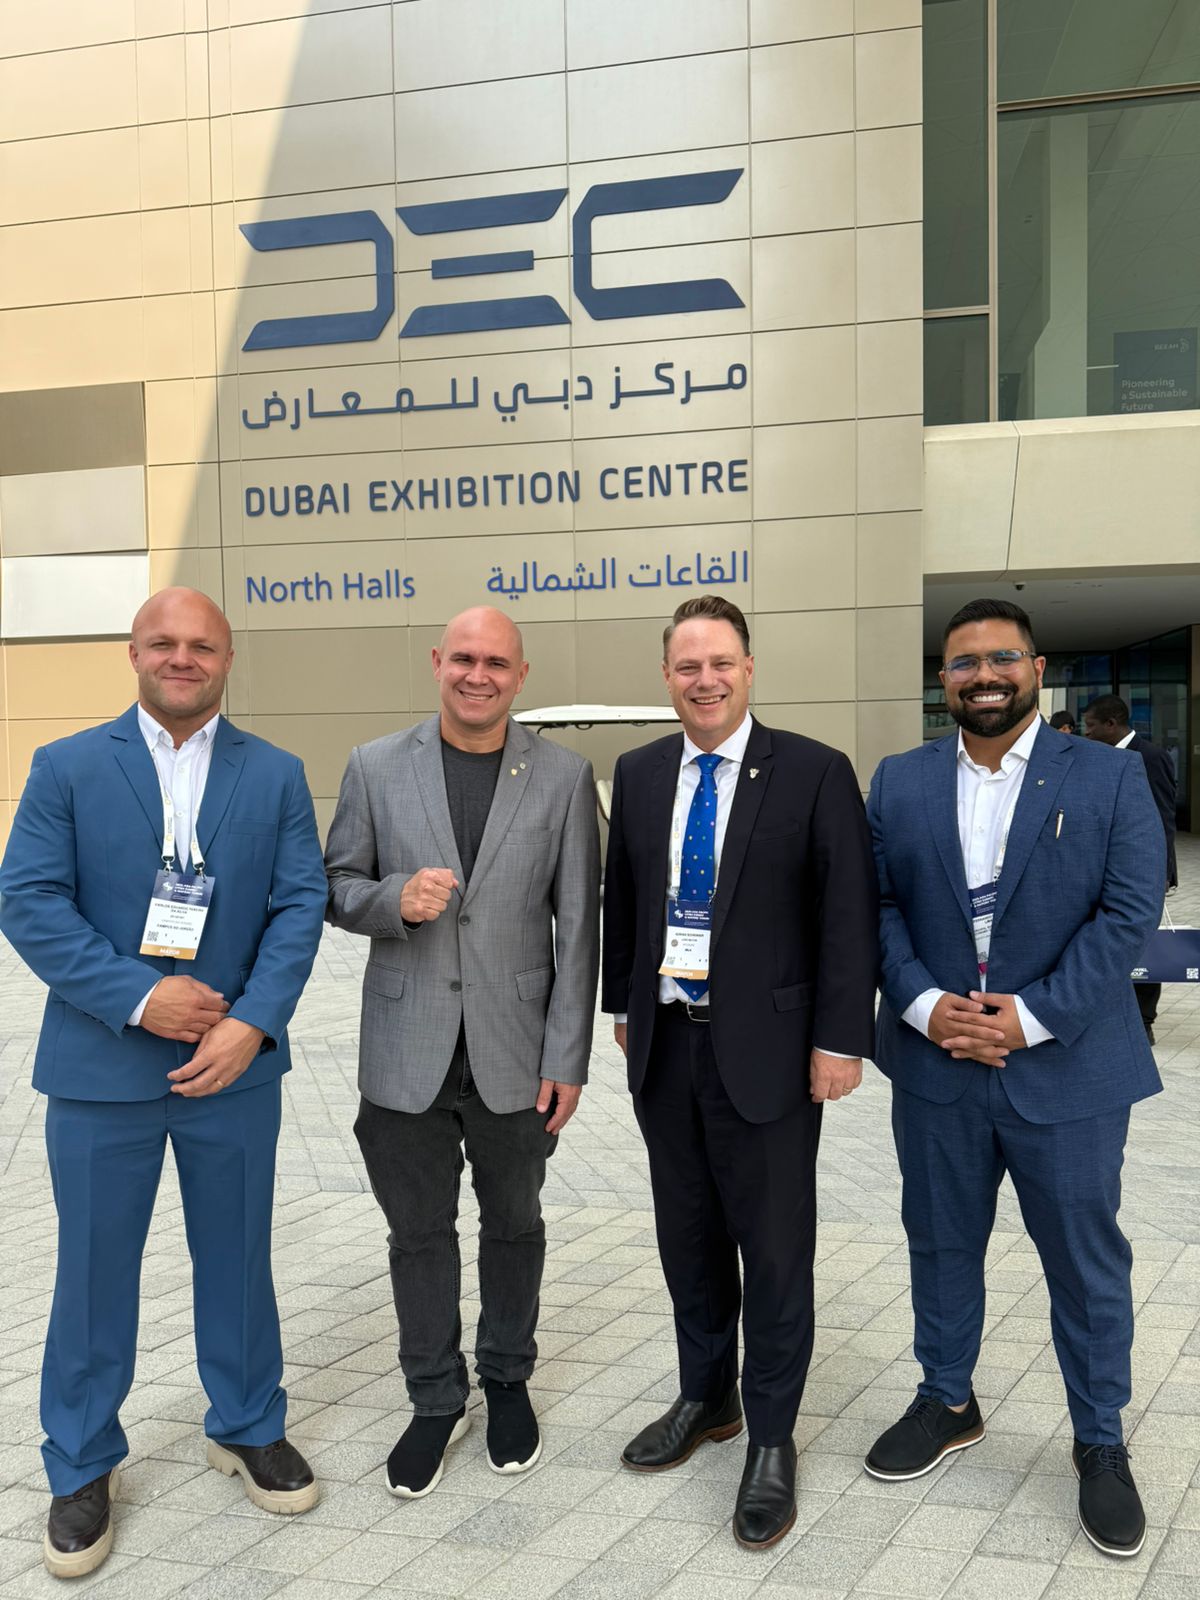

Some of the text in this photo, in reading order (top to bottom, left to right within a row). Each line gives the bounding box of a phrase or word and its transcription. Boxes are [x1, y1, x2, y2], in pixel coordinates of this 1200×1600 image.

[240, 168, 745, 352] DEC
[241, 362, 748, 431] مركز دبي للمعارض
[1121, 378, 1175, 388] Pioneering
[1129, 388, 1188, 400] Sustainable
[1121, 402, 1154, 412] Future
[245, 459, 749, 518] DUBAI EXHIBITION CENTRE
[245, 569, 416, 605] North Halls
[486, 550, 749, 601] القاعات الشمالية
